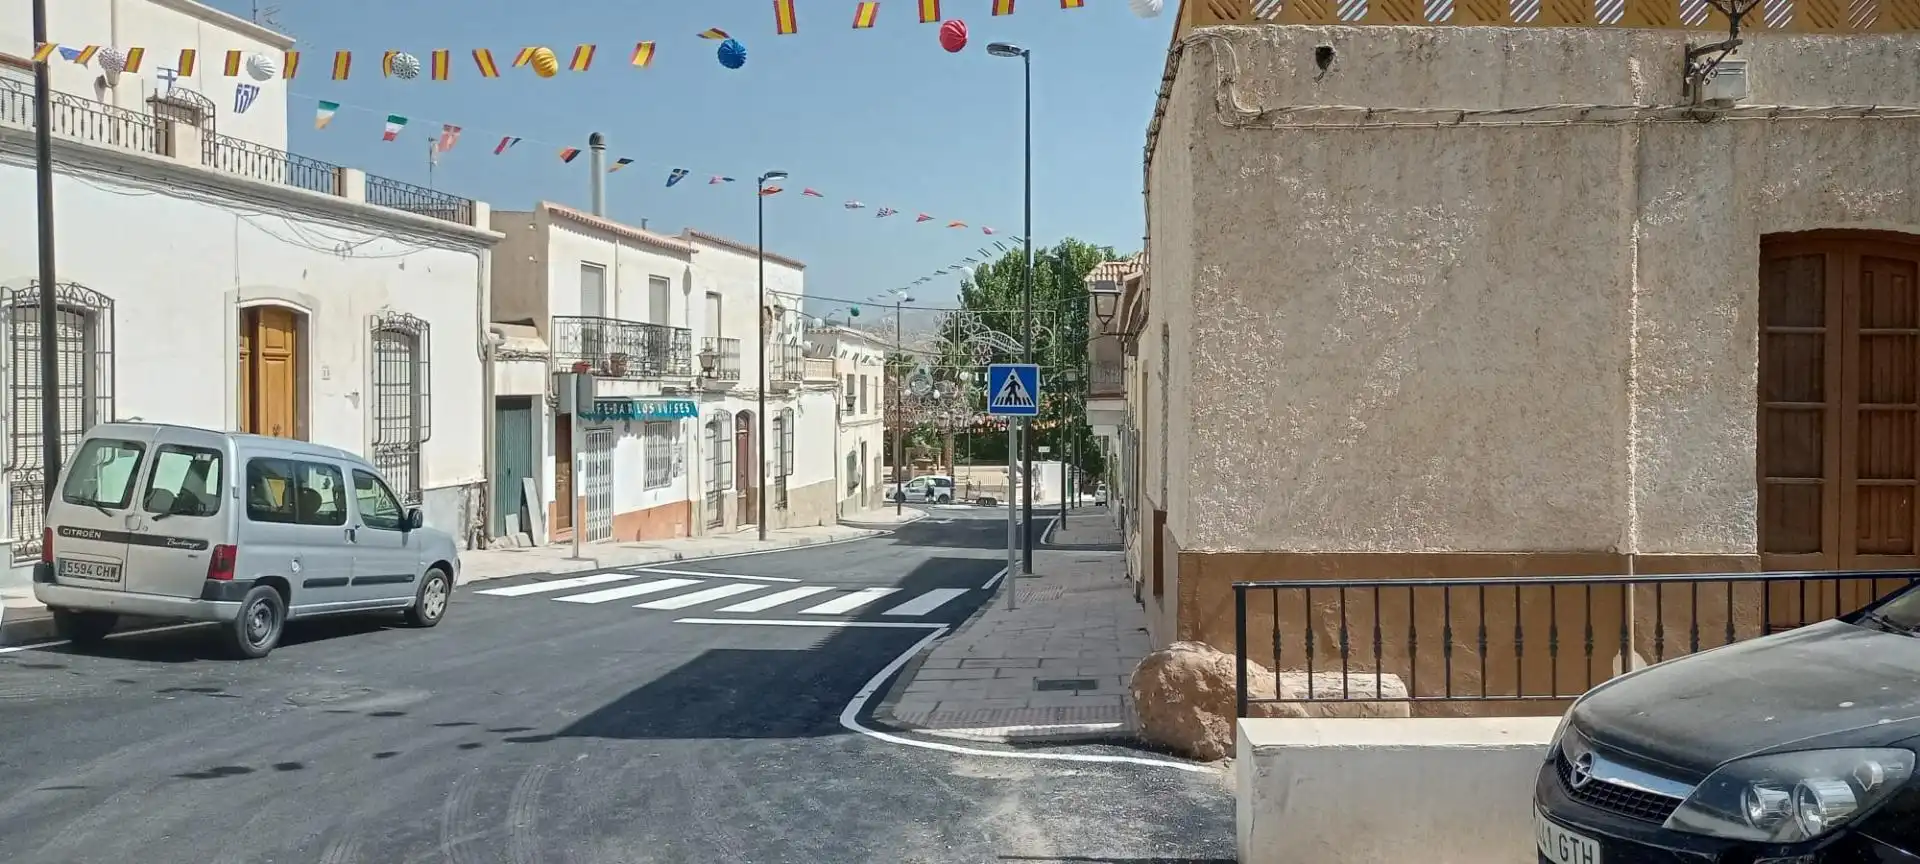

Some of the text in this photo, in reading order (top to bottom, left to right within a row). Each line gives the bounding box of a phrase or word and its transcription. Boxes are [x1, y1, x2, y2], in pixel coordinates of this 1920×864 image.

[636, 402, 655, 414] LOS
[657, 402, 690, 414] LUISES
[62, 528, 102, 539] CITROËN
[66, 561, 93, 575] 5594
[1559, 832, 1593, 864] GTH
